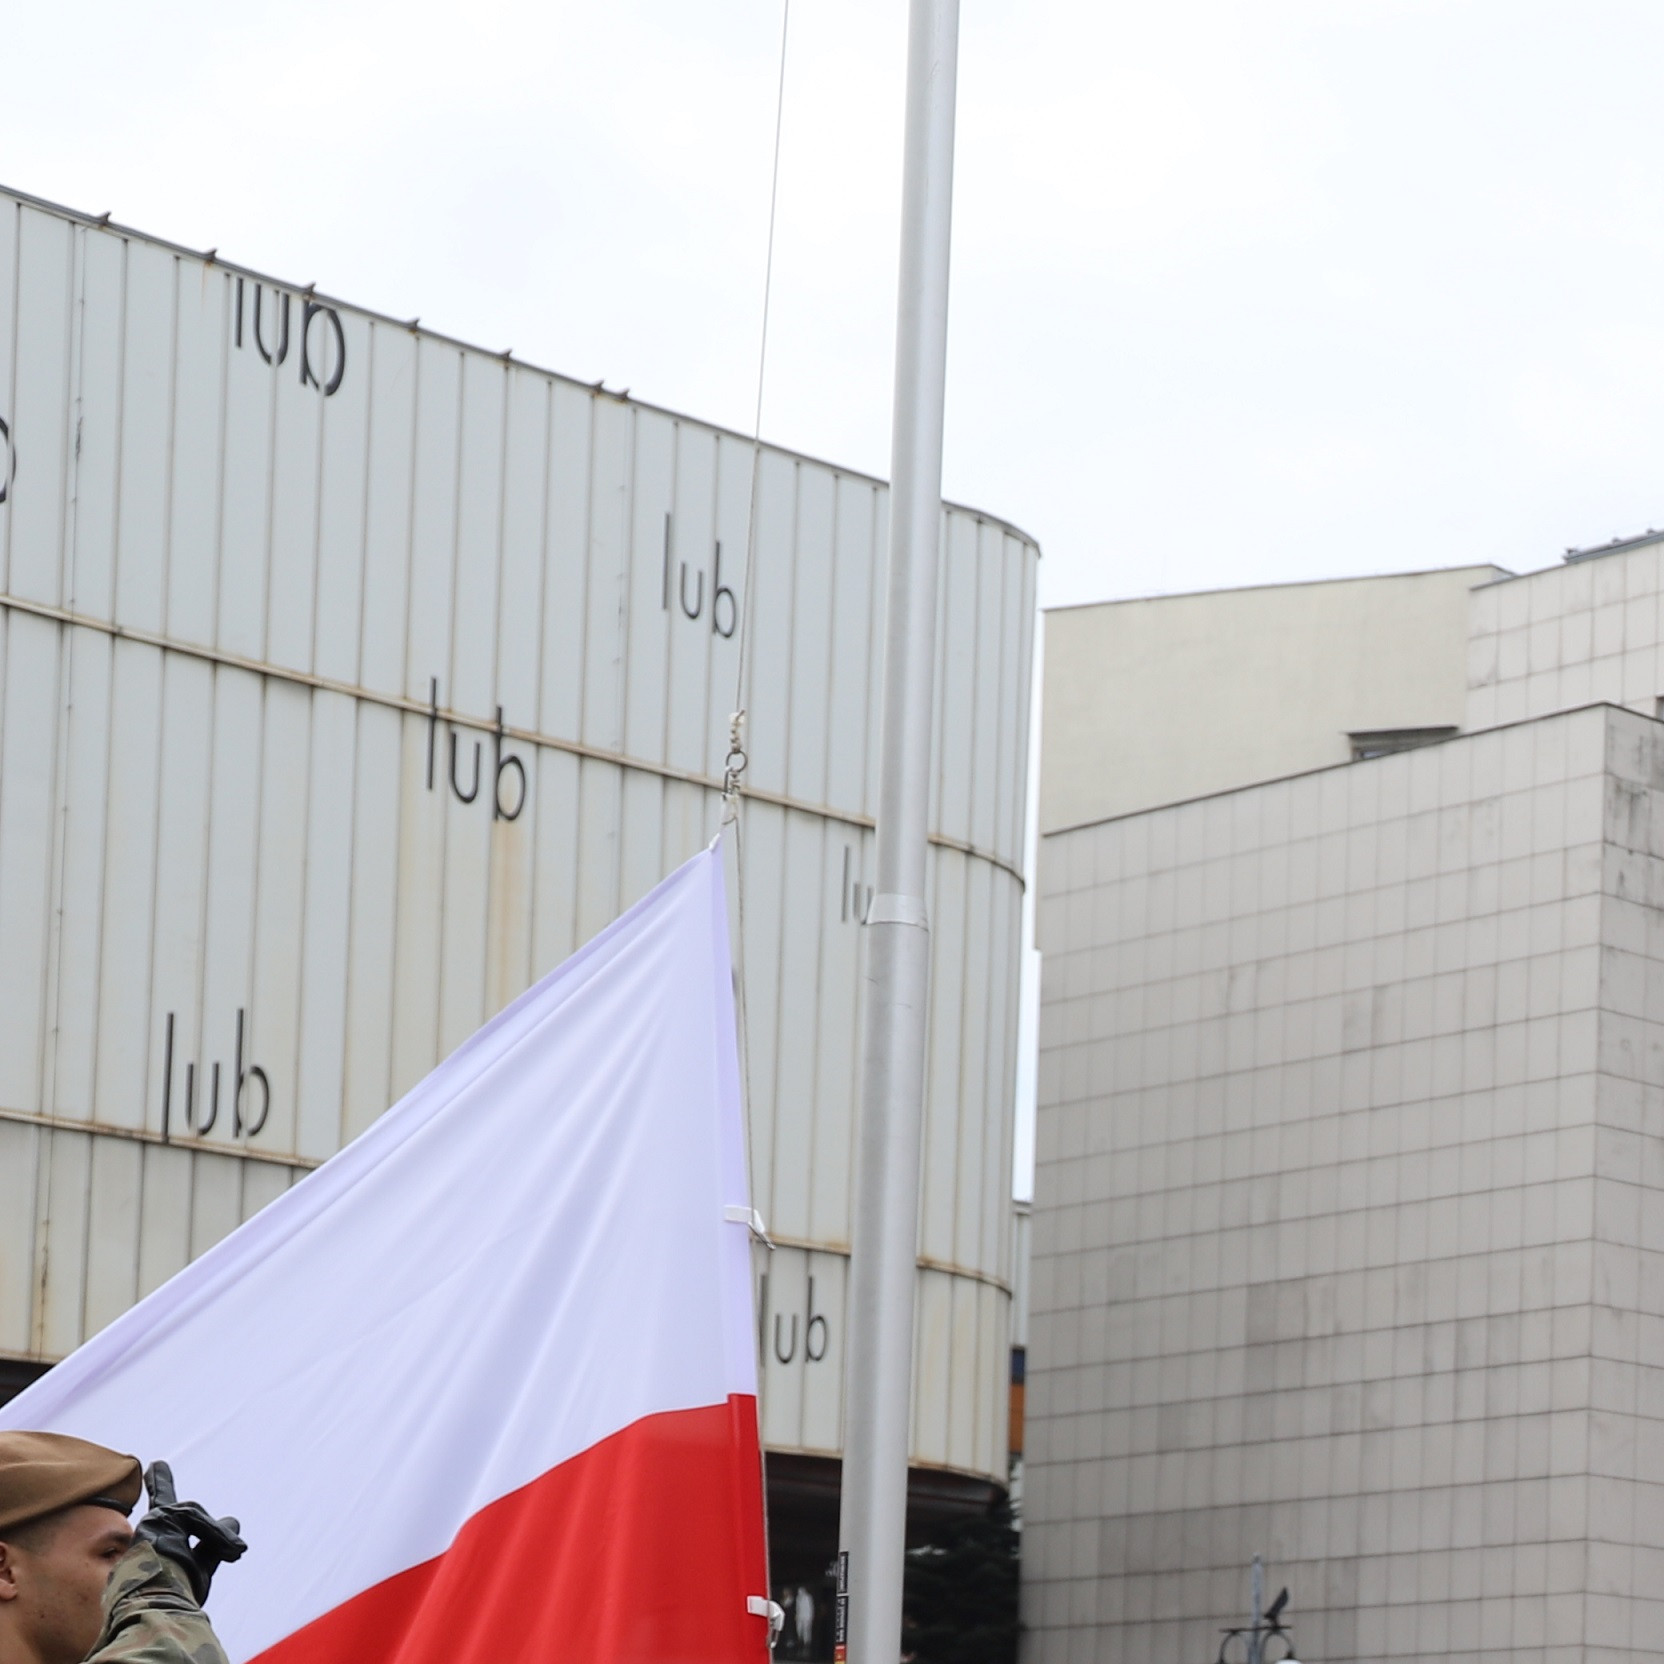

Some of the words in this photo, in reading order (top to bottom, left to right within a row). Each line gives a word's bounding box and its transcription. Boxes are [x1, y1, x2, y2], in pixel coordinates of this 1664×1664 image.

[662, 513, 737, 638] lub
[427, 677, 526, 822] lub
[840, 845, 876, 925] lu
[161, 1008, 271, 1143] lub
